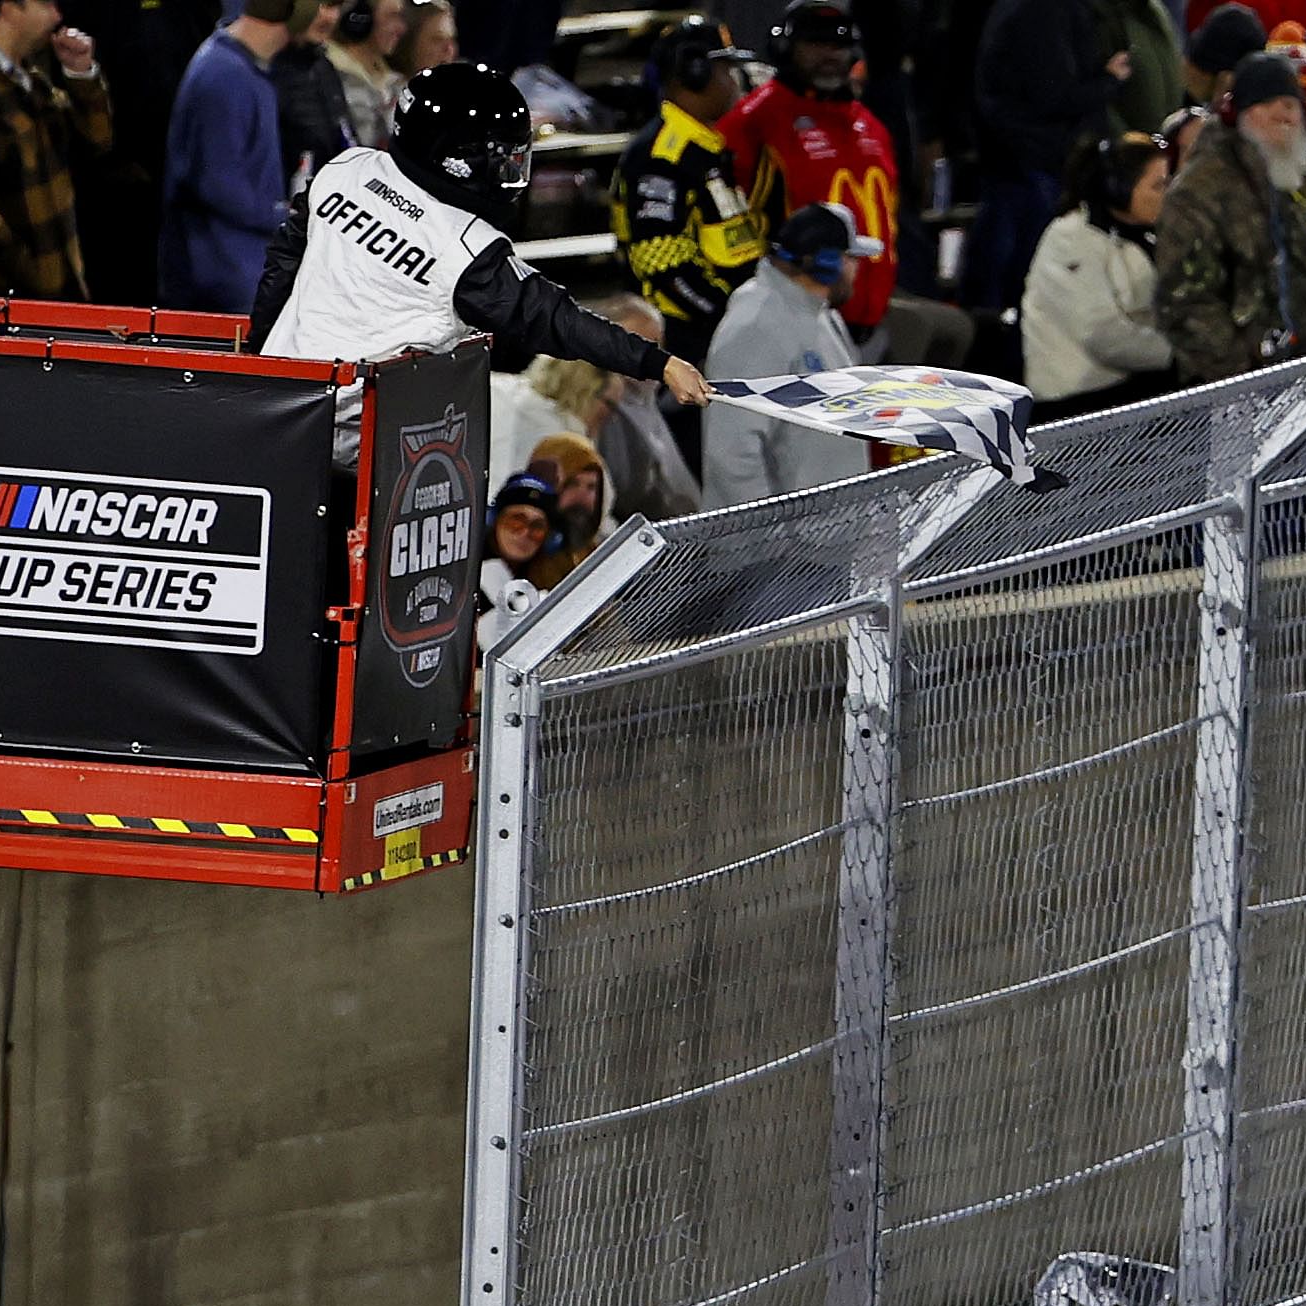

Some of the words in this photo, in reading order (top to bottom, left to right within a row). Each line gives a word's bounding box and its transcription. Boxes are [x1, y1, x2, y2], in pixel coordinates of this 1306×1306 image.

[375, 187, 425, 222] NASCAR
[316, 192, 438, 286] OFFICIAL
[28, 485, 219, 545] NASCAR
[390, 507, 471, 577] CLASH
[58, 561, 218, 613] SERIES
